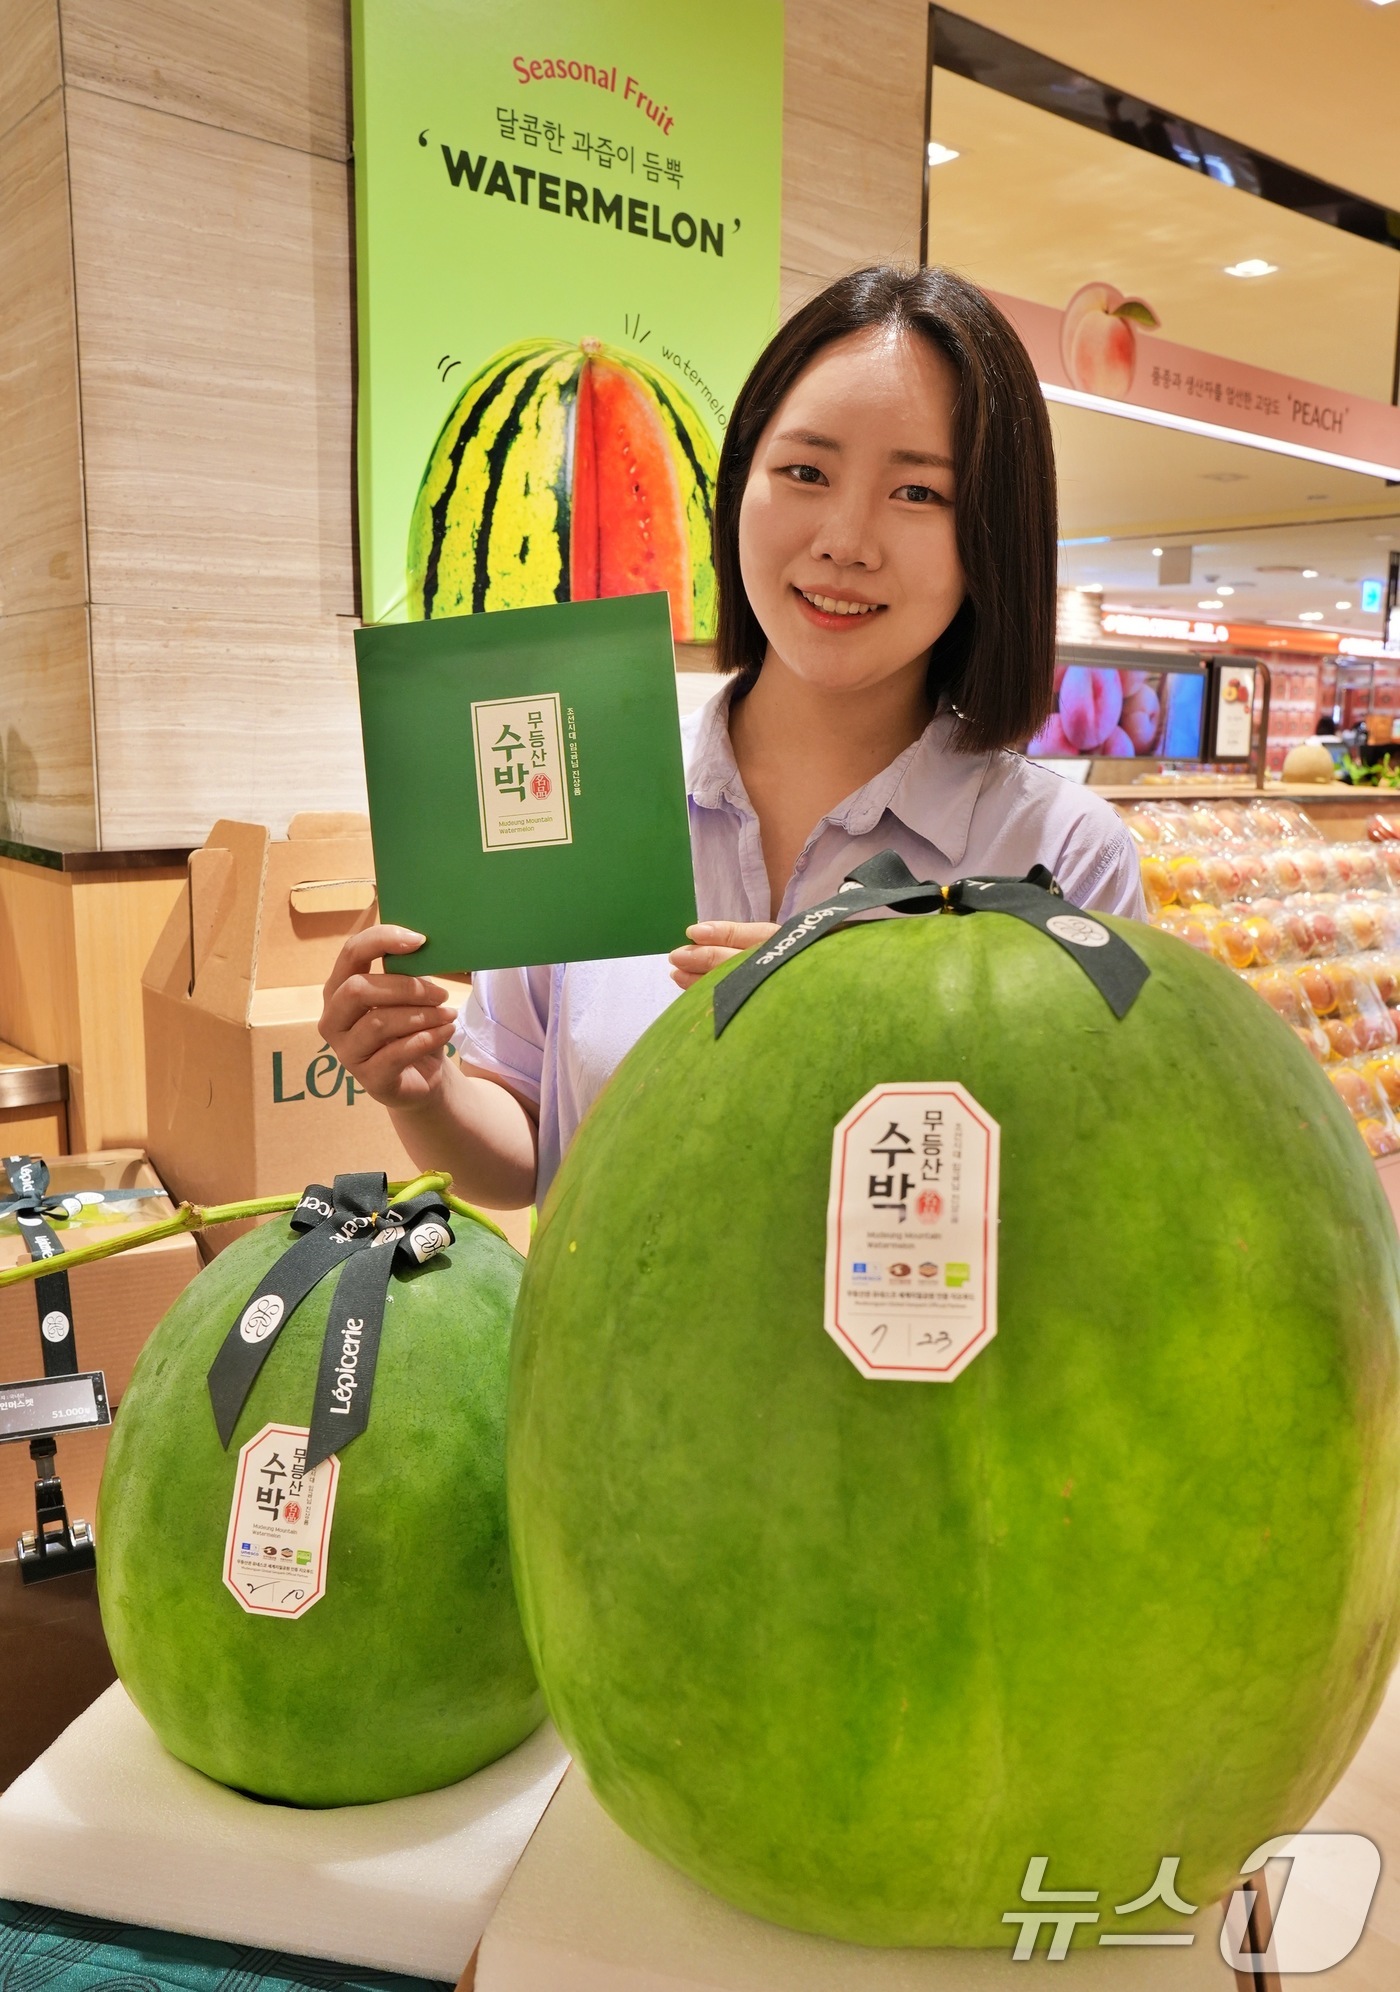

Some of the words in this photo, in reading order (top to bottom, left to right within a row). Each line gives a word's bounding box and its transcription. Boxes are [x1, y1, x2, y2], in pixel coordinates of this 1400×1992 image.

[513, 56, 616, 93] Seasonal
[623, 76, 674, 136] Fruit
[496, 106, 566, 154] 달콤한
[571, 130, 635, 174] 과즙이
[642, 151, 684, 190] 듬뿍
[662, 346, 728, 430] watermelo
[527, 711, 548, 768] 무등산
[567, 707, 577, 740] 조선시대
[491, 724, 530, 803] 수박
[570, 743, 579, 769] 임금님
[572, 770, 581, 796] 진상품
[498, 818, 525, 828] Mudeung
[526, 816, 553, 825] Mountain
[499, 825, 535, 835] Watermelon
[869, 1122, 916, 1224] 수박
[922, 1110, 943, 1181] 무등산
[330, 1318, 364, 1414] Lépicerie
[256, 1452, 287, 1522] 수박
[289, 1448, 306, 1496] 무등산
[252, 1530, 281, 1538] Watermelon
[253, 1523, 274, 1532] Mudeung
[275, 1527, 298, 1535] Mountain
